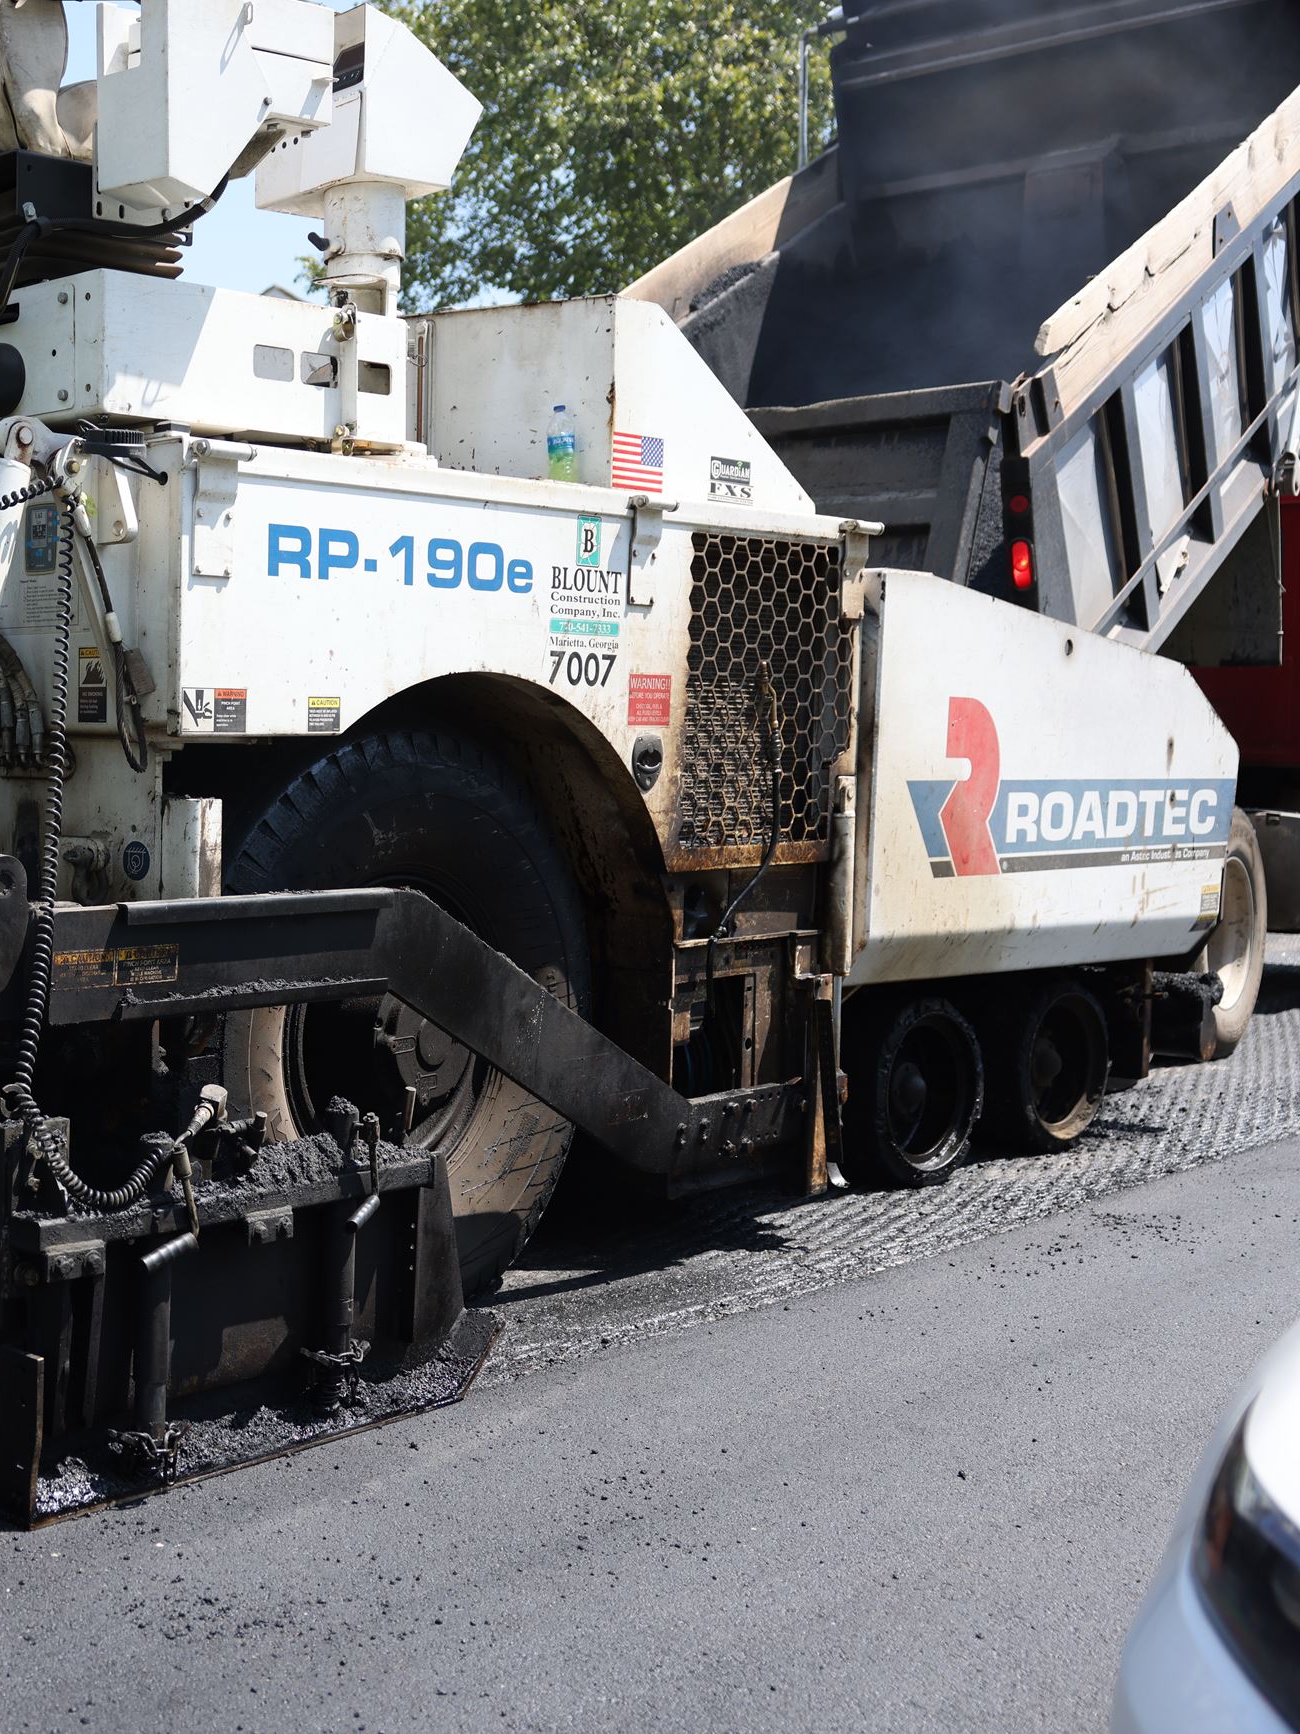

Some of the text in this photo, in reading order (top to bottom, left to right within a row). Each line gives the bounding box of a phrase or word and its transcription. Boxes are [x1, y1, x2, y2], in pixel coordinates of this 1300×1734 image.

[710, 482, 751, 498] FXS
[551, 566, 622, 594] BLOUNT
[551, 591, 621, 606] Construction
[550, 604, 620, 619] Company, Inc.
[588, 639, 619, 650] Georgia
[549, 651, 617, 687] 7007
[631, 677, 670, 690] WARNING!!
[1005, 789, 1218, 844] ROADTEC
[1121, 853, 1130, 862] an
[1151, 849, 1181, 860] Industes
